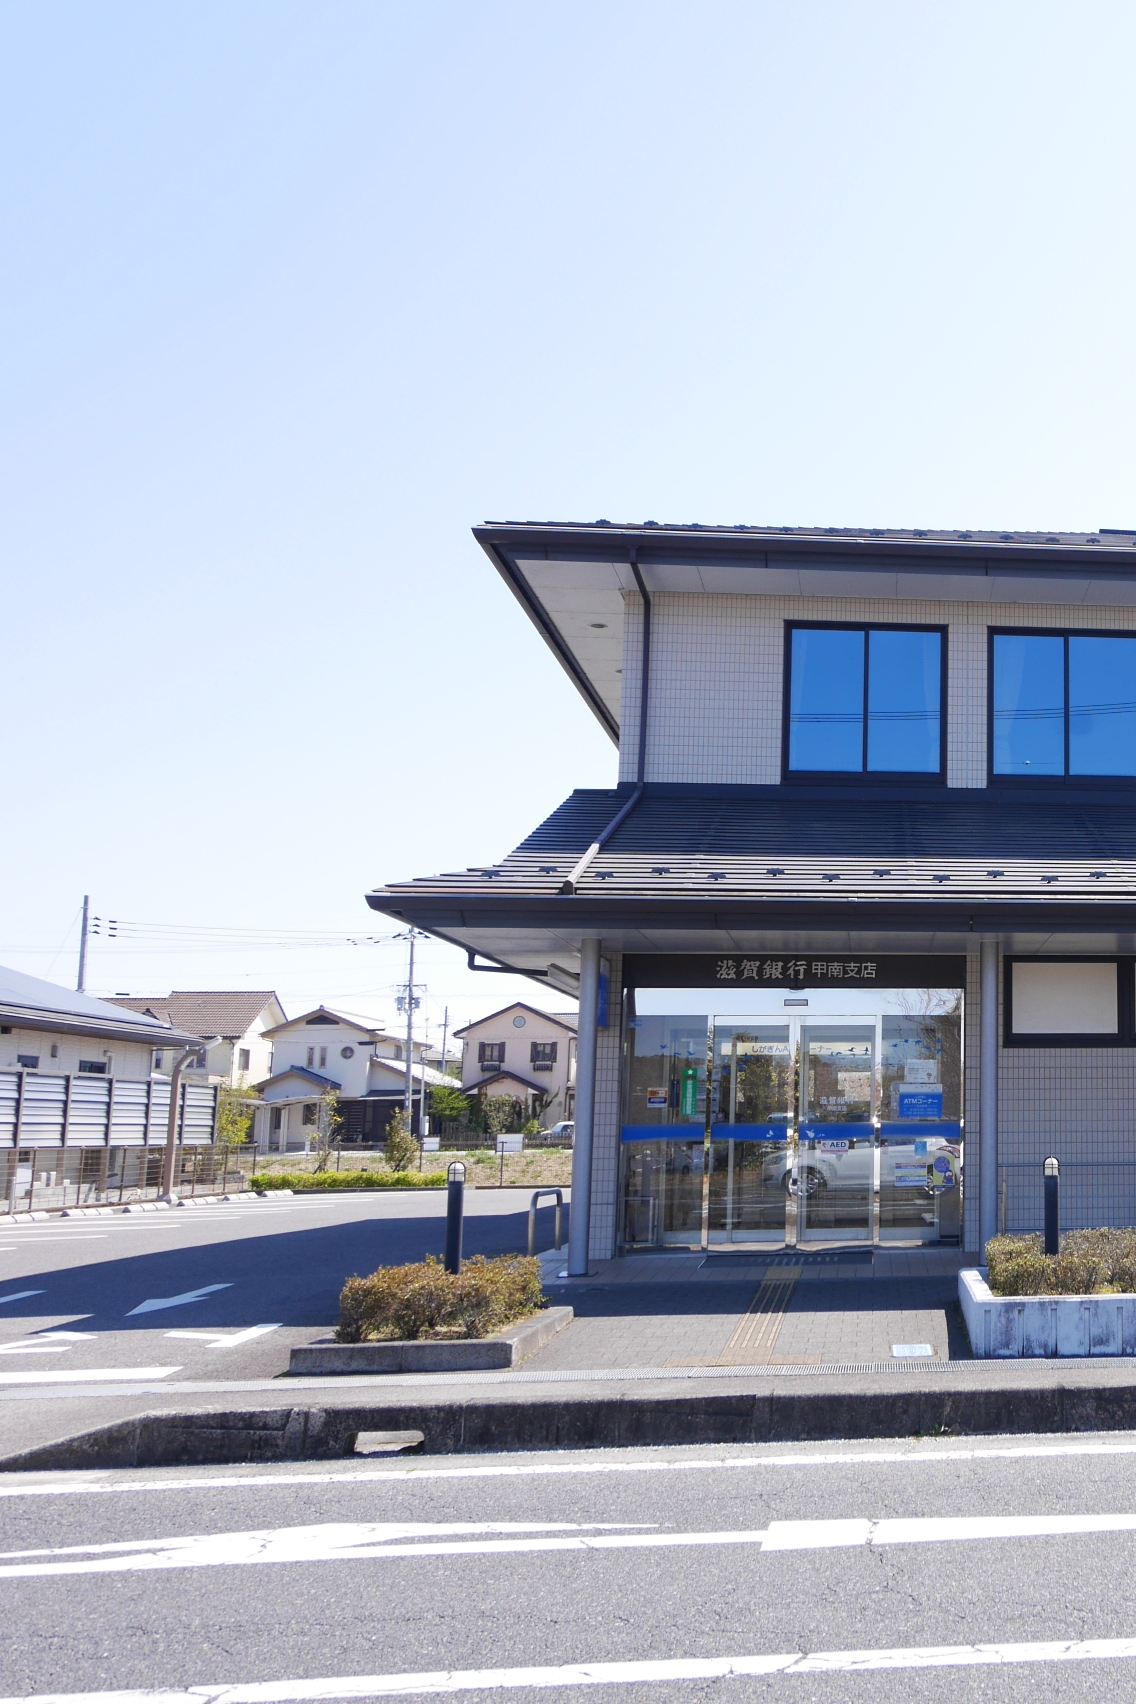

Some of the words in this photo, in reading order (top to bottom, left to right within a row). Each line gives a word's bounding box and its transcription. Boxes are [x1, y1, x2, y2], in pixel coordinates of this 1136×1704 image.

[715, 959, 808, 980] 滋賀銀行
[811, 961, 877, 978] 甲南支店
